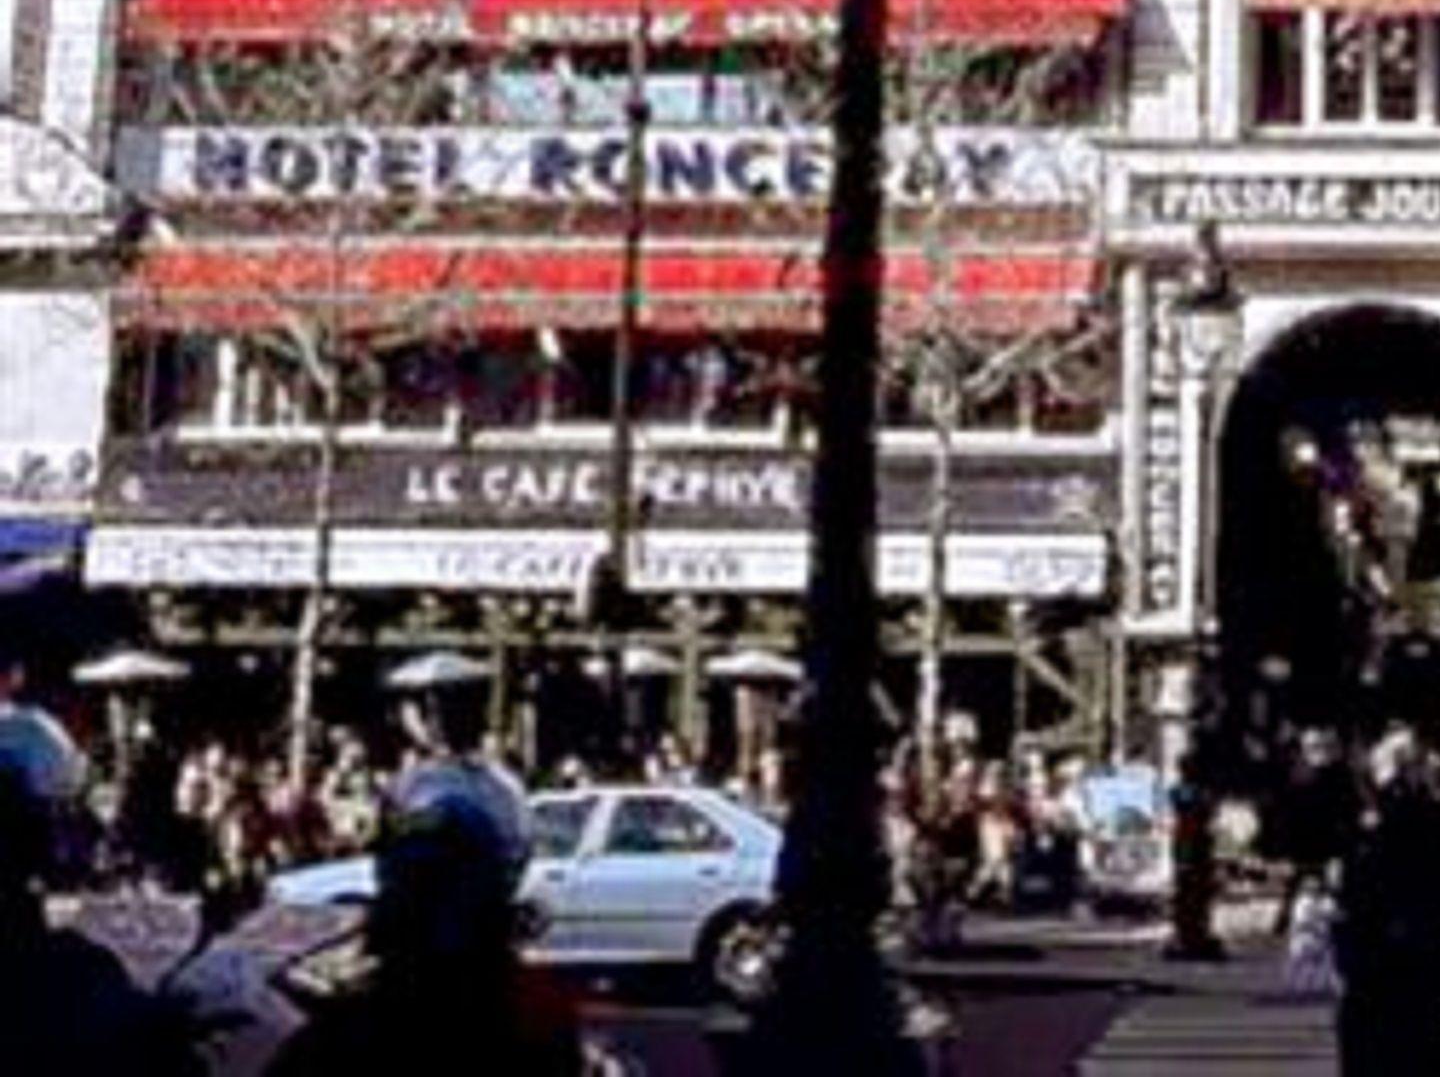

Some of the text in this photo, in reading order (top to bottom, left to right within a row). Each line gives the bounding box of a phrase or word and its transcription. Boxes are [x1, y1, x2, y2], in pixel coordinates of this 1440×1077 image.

[193, 134, 470, 195] HOTEL
[529, 136, 1008, 198] RONCEAY
[407, 467, 464, 503] LE
